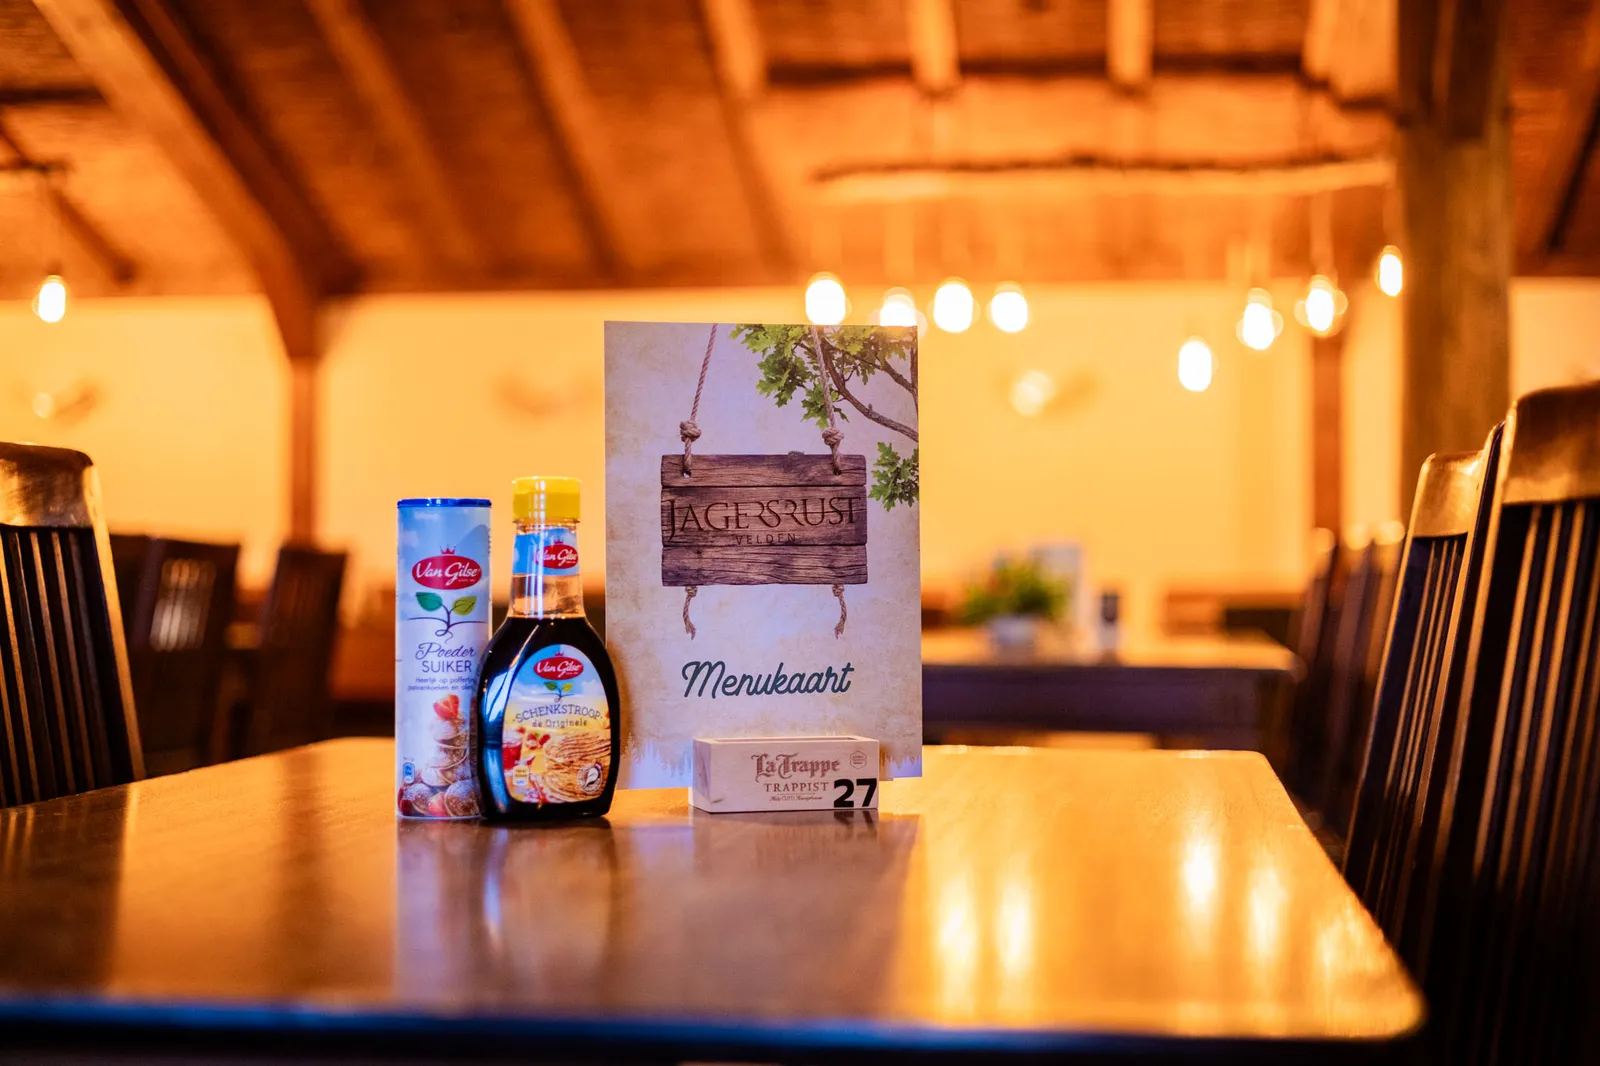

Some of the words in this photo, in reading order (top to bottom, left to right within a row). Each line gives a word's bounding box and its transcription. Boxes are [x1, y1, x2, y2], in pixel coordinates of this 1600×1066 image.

[661, 497, 861, 542] JAGERSRUST
[735, 533, 796, 545] VELDEN
[416, 562, 443, 578] Van
[444, 562, 478, 586] Gilse
[415, 642, 477, 660] Poeder
[421, 660, 472, 673] SUIKER
[536, 661, 556, 673] Van
[557, 661, 580, 678] Gilse
[681, 660, 855, 699] Menukaart
[515, 703, 601, 723] SCHENKSTROOP
[532, 719, 543, 728] de
[545, 718, 588, 729] Originele
[751, 753, 777, 783] La
[775, 751, 840, 779] Trappe
[763, 782, 830, 793] TRAPPIST
[833, 778, 878, 808] 27
